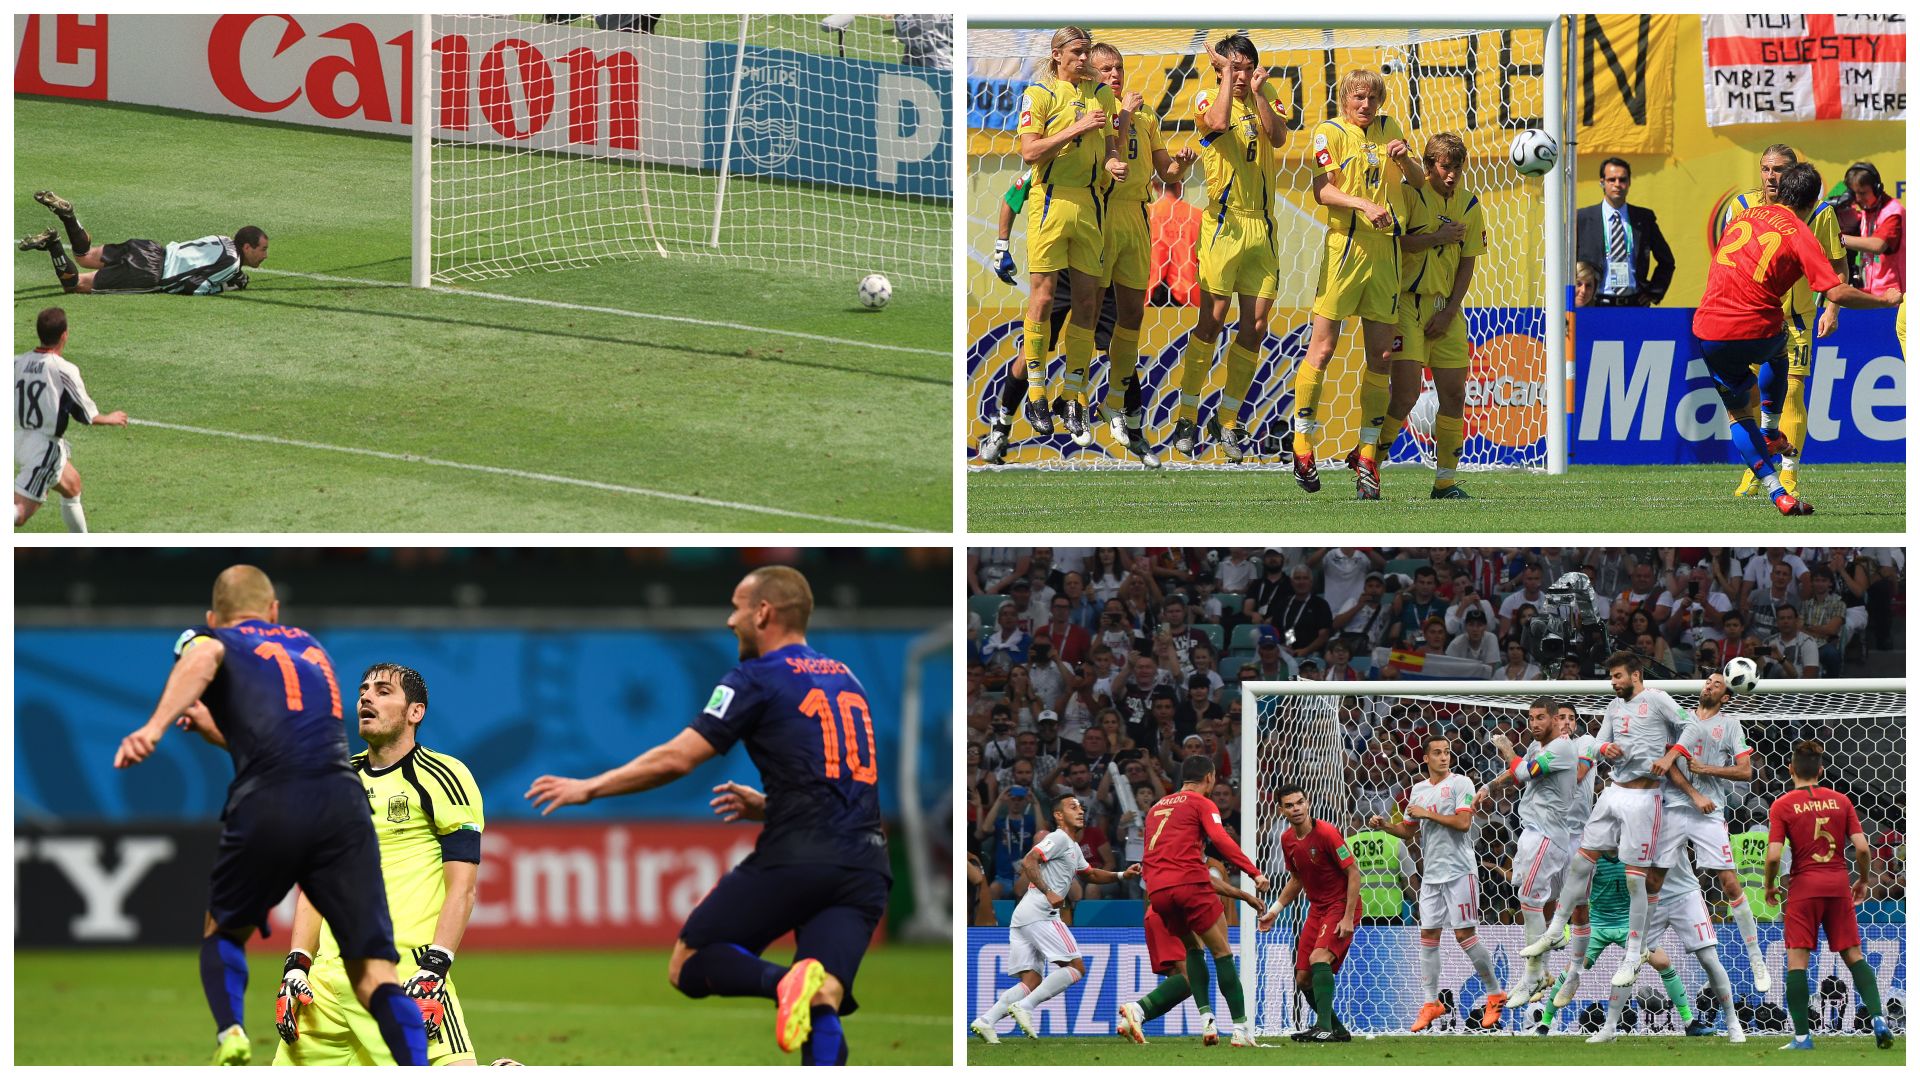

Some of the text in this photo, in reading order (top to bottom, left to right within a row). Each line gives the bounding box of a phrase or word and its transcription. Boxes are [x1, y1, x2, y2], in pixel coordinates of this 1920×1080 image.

[1761, 36, 1880, 63] GUESTY
[207, 14, 640, 151] Canon
[740, 65, 796, 87] PHILIPS
[1128, 139, 1138, 159] 9
[1246, 141, 1257, 162] 6
[1365, 168, 1379, 189] 14
[1716, 221, 1782, 284] 21
[1793, 345, 1809, 366] 10
[1579, 340, 1906, 441] Mate
[16, 379, 46, 430] 18
[254, 641, 343, 719] 11
[799, 687, 877, 785] 10
[1793, 799, 1840, 814] RAPHAEL
[1148, 808, 1174, 851] 7
[1811, 817, 1836, 863] 5
[1638, 844, 1648, 861] 3
[1722, 845, 1732, 862] 5
[1742, 838, 1768, 855] 879
[14, 838, 174, 940] Y
[1458, 902, 1472, 921] 11
